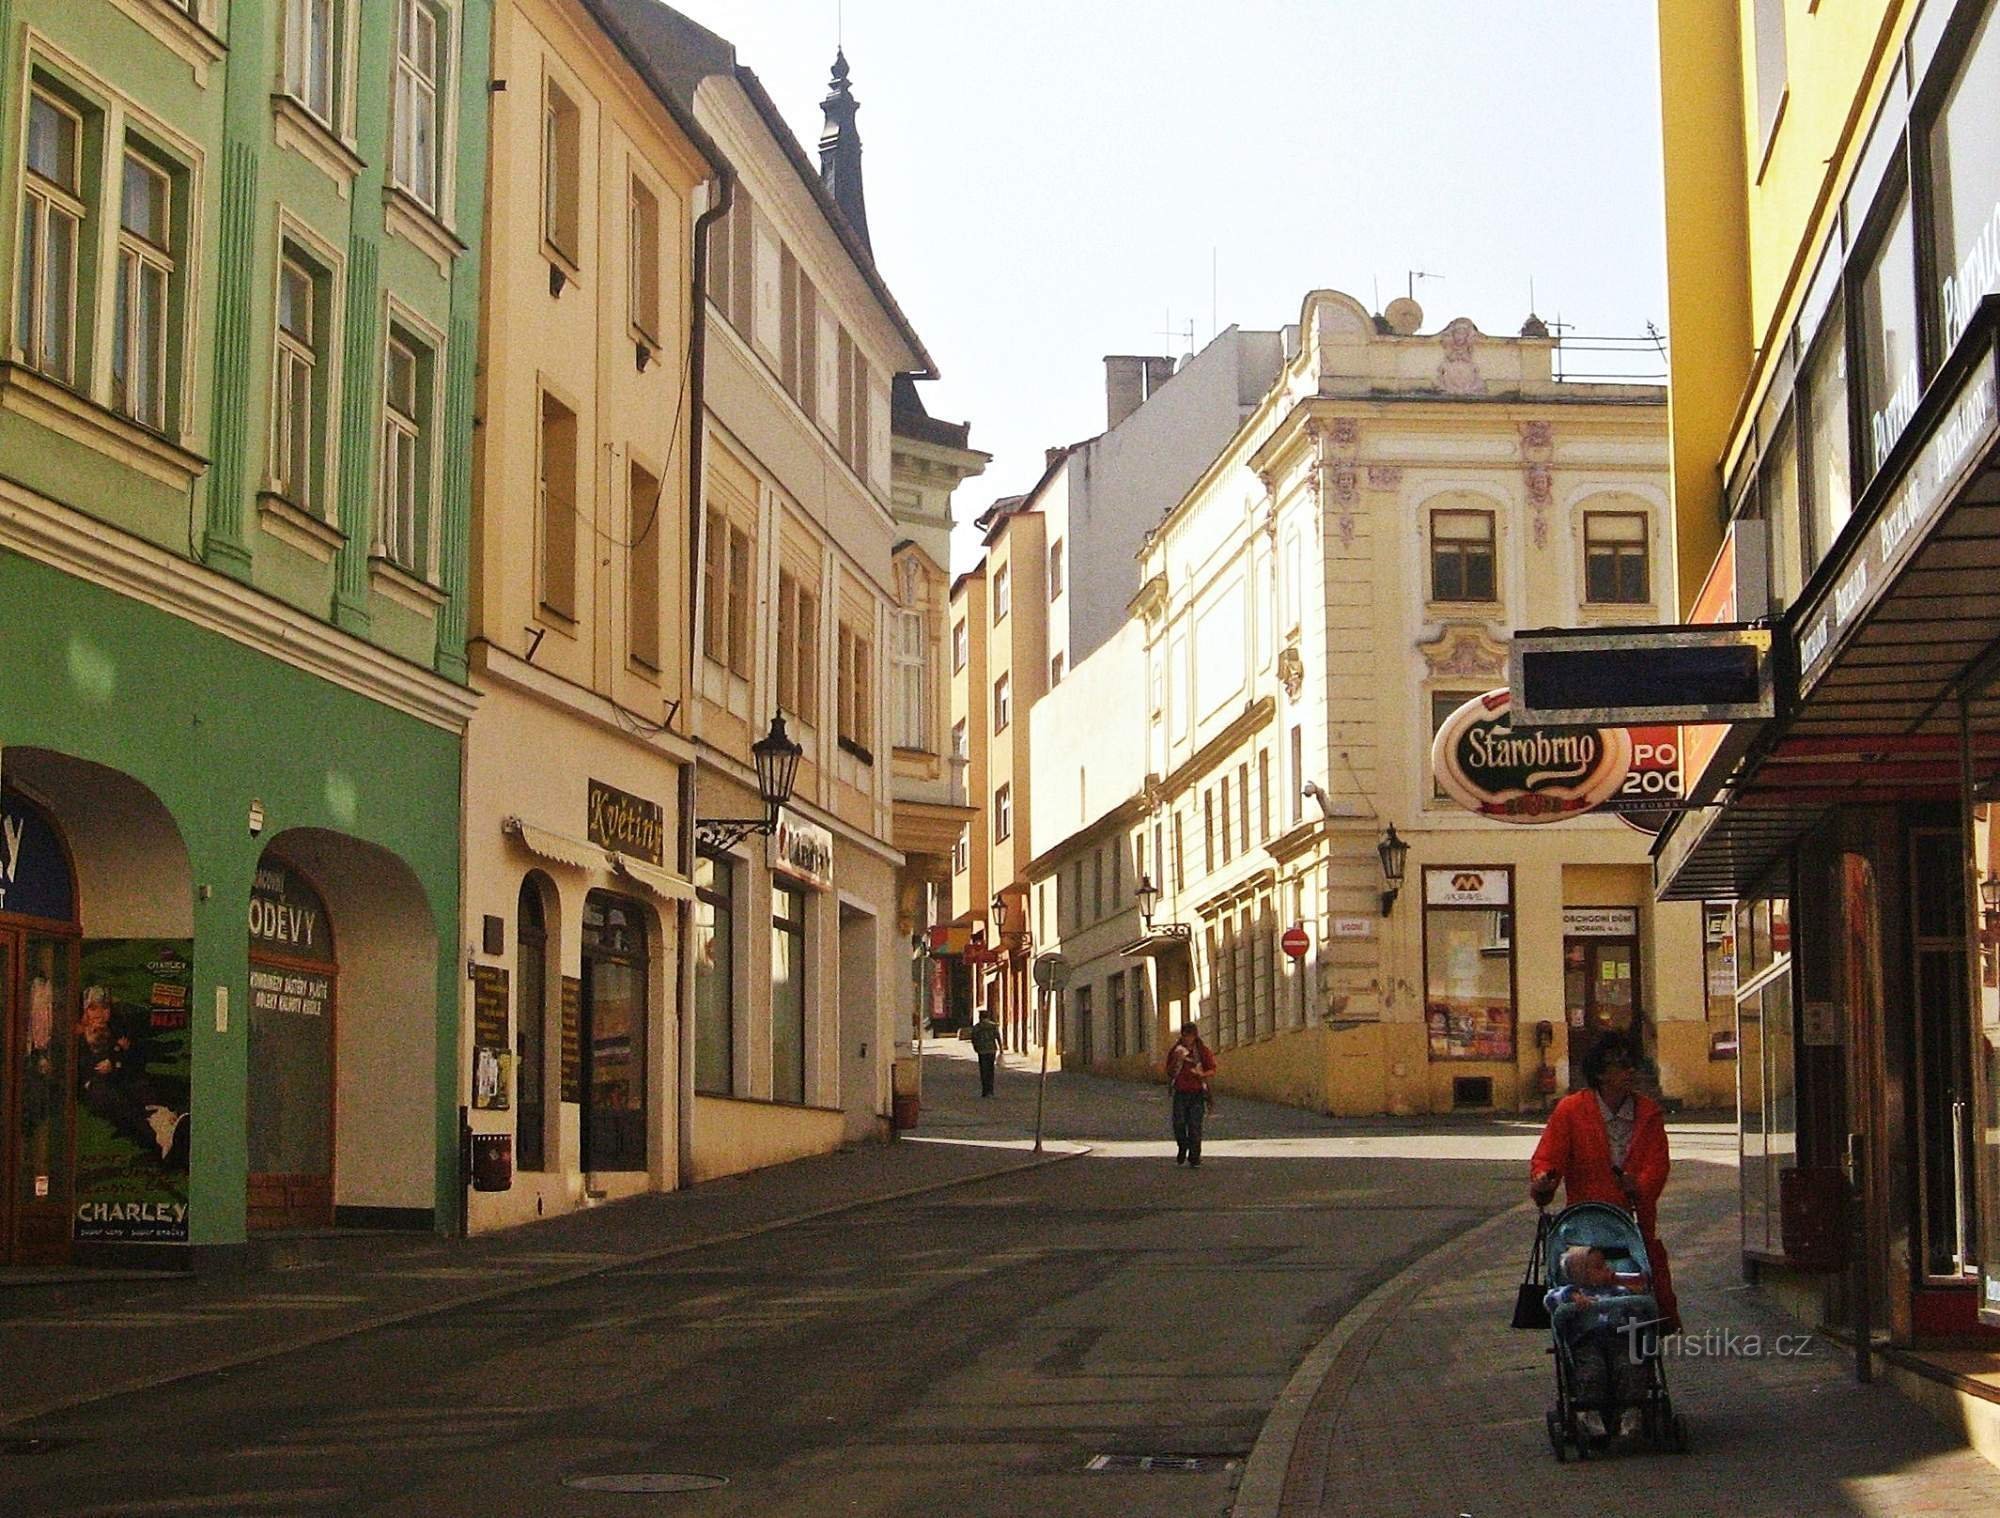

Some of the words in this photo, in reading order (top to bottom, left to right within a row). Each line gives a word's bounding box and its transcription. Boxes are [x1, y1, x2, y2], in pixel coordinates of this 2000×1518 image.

[1469, 728, 1595, 769] Starobrno
[248, 894, 316, 945] ODĚVY
[78, 1202, 188, 1223] CHARLEY
